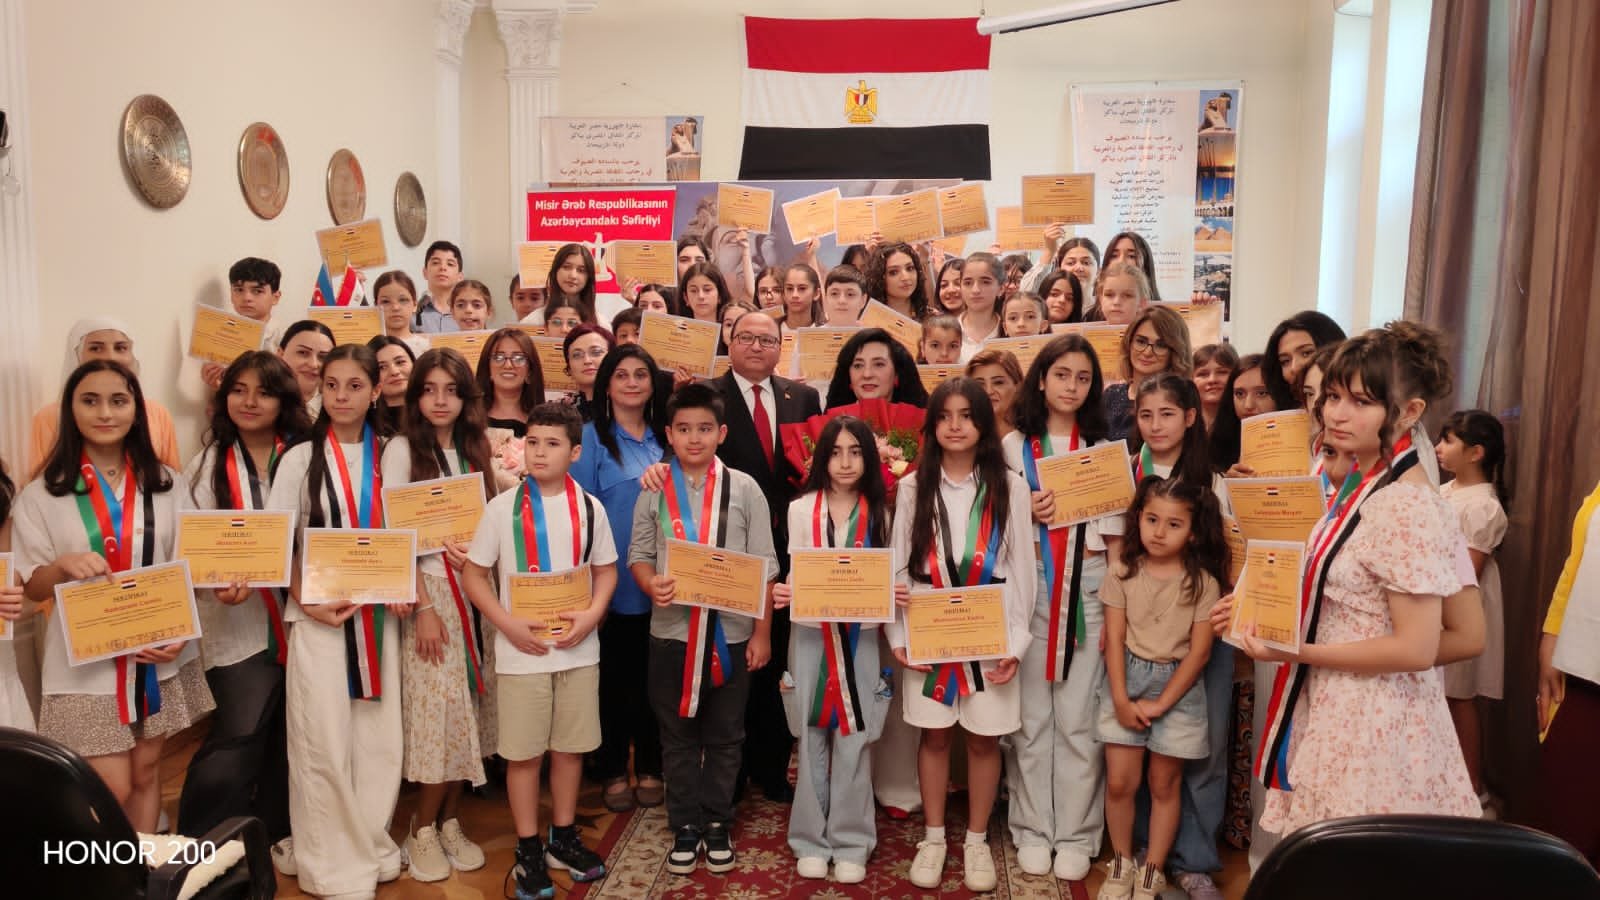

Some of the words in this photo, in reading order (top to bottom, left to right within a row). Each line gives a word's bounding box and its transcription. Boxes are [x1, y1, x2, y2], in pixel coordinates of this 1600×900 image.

[561, 199, 586, 210] Ərəb
[588, 198, 669, 212] Respublikasının
[540, 215, 619, 228] Azərbaycandakı
[621, 214, 661, 228] Səfirliyi
